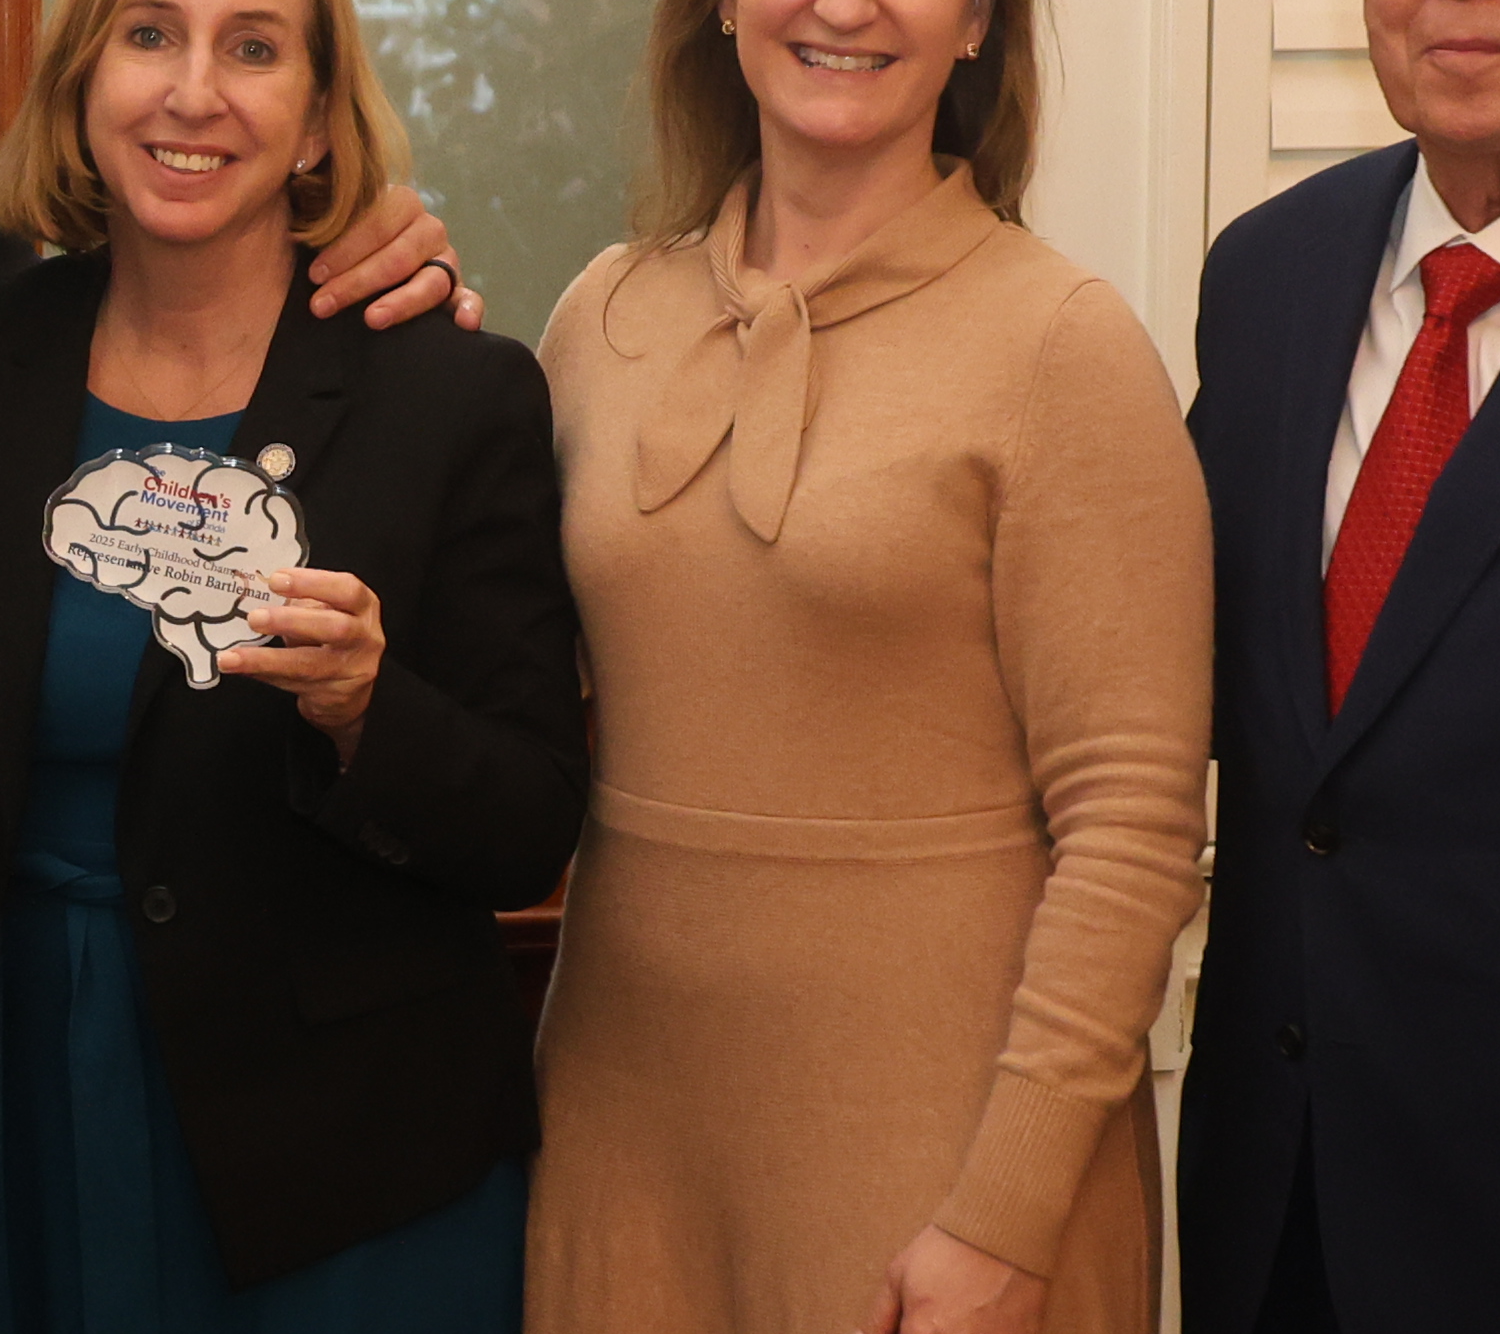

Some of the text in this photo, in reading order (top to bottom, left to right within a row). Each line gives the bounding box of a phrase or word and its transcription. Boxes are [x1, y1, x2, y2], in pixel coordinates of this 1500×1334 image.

[140, 490, 229, 523] Movement
[89, 533, 256, 582] 2025 Early Childhood Champion
[164, 565, 202, 586] Robin
[205, 575, 271, 601] Bartleman
